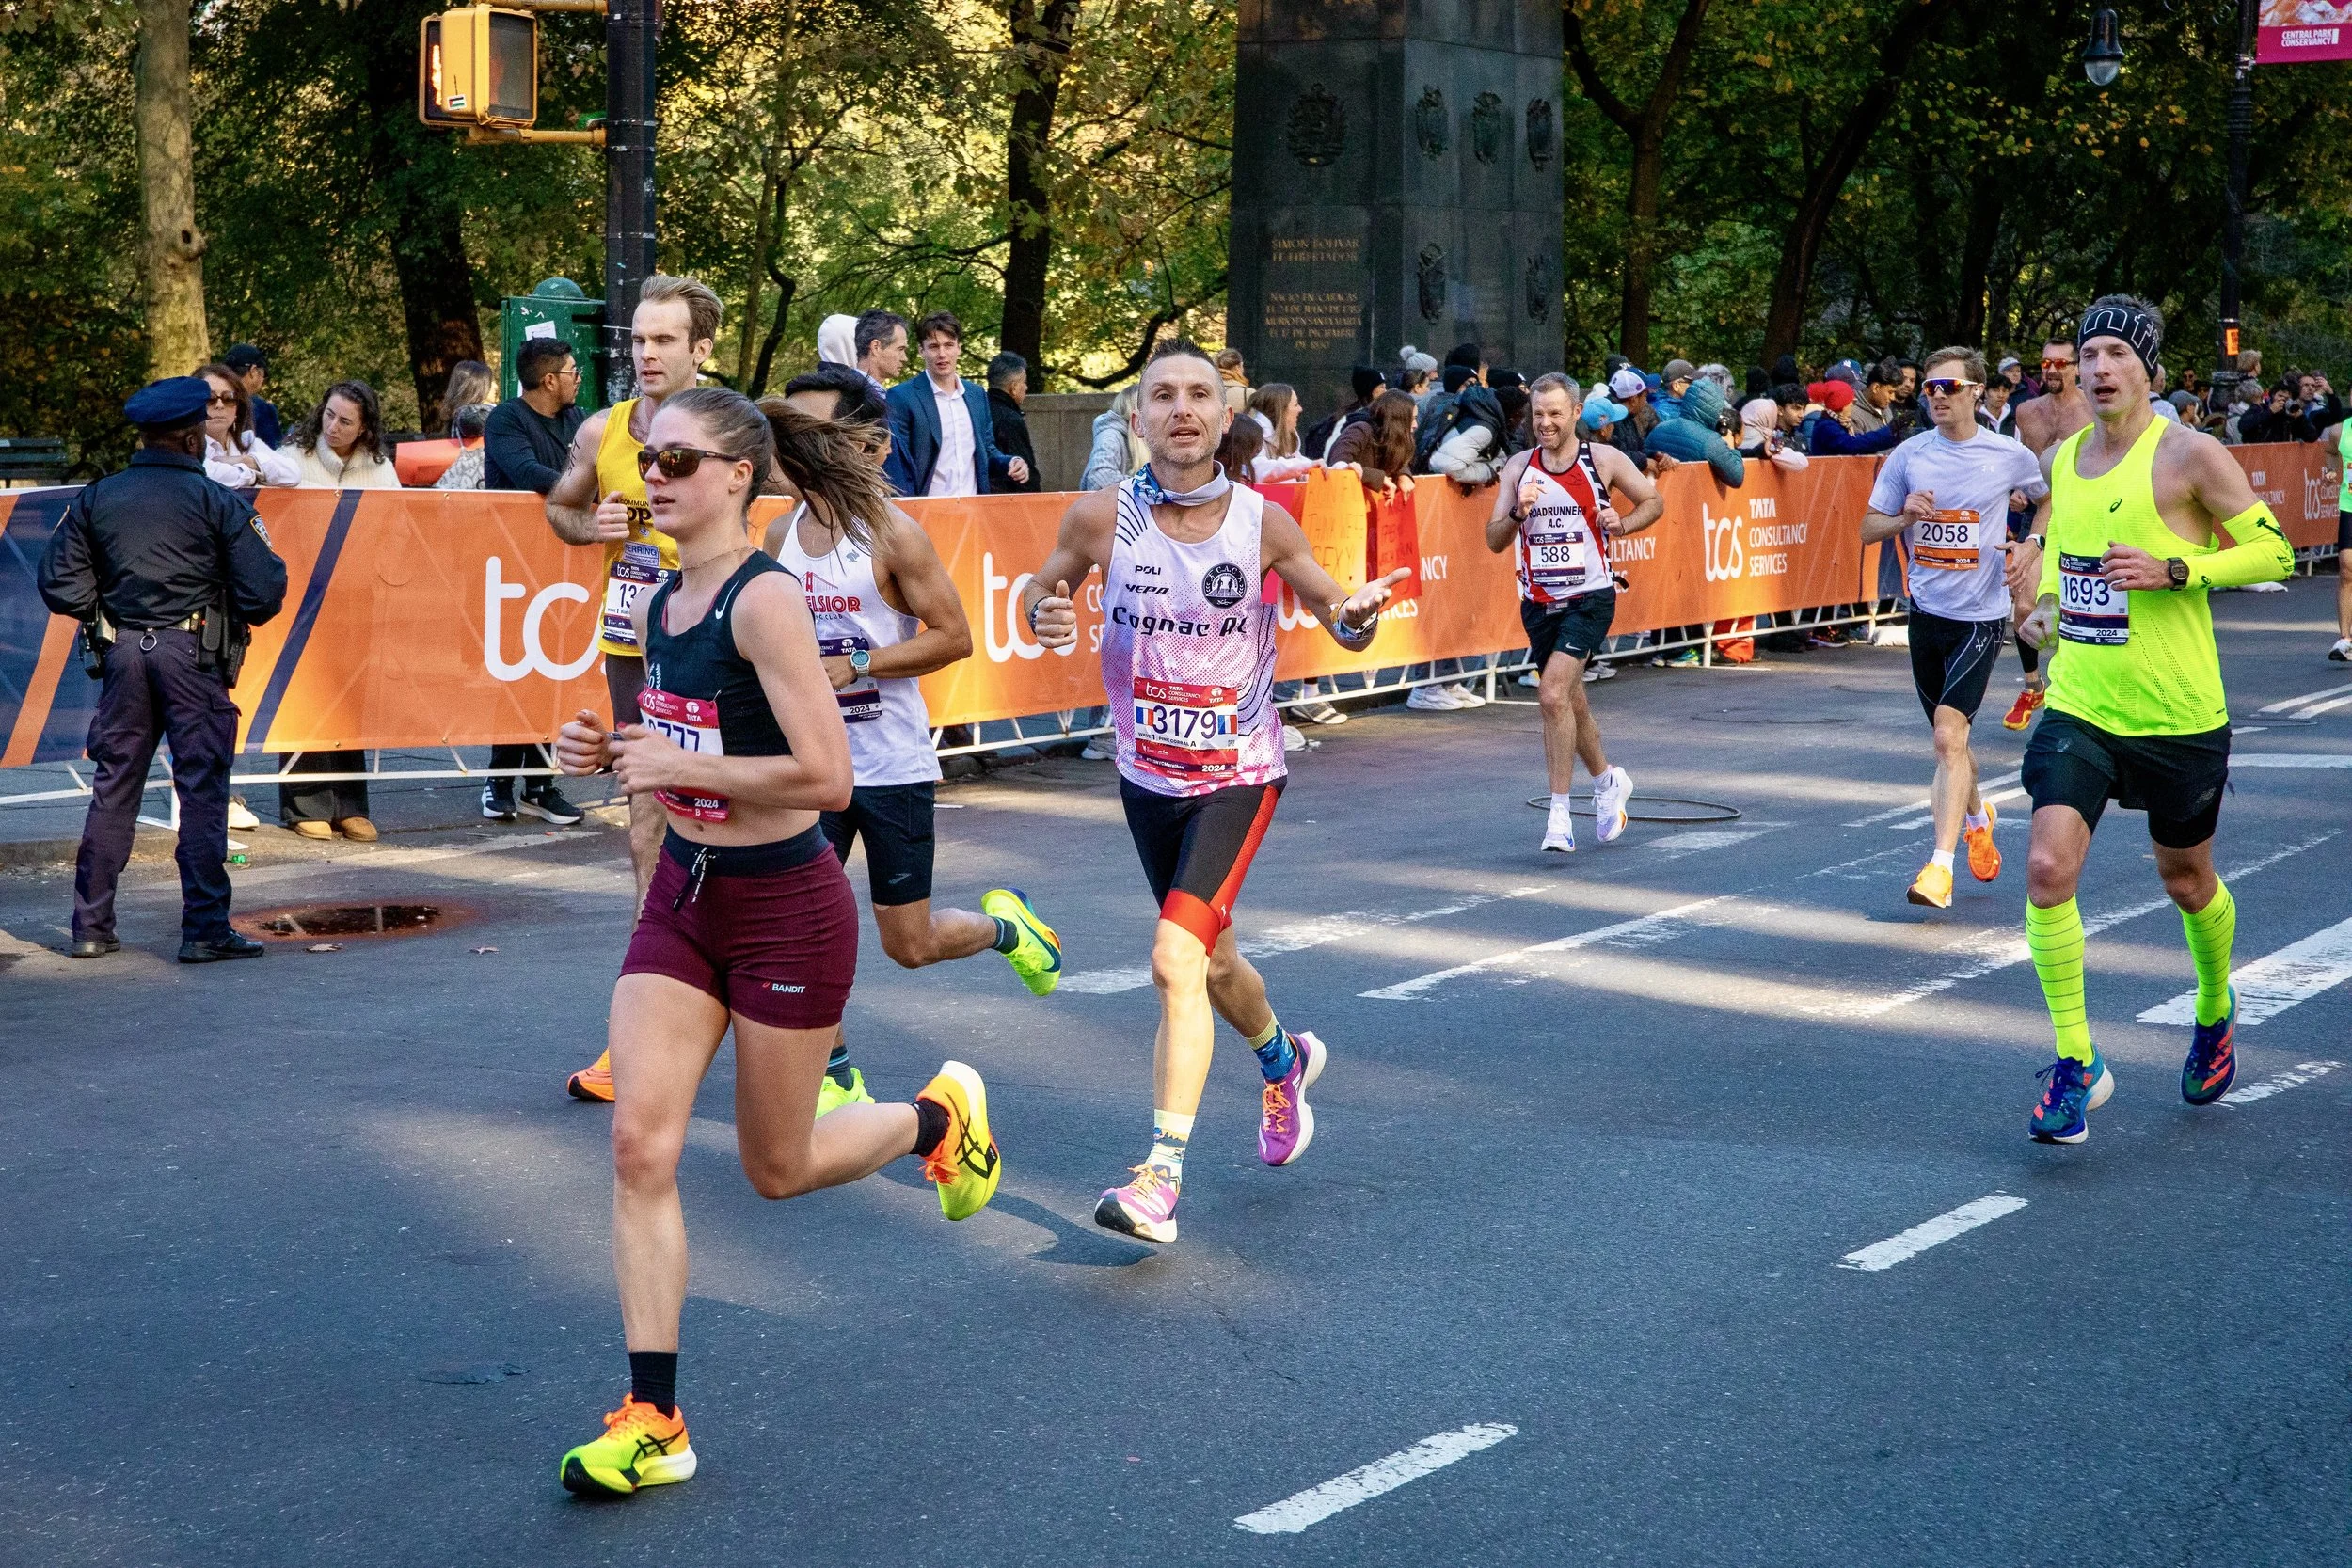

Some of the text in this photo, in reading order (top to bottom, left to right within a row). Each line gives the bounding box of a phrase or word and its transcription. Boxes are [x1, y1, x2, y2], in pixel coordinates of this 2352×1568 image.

[2281, 28, 2333, 40] CENTRAL PARK
[2281, 38, 2331, 47] CONSERVANCY
[2304, 468, 2321, 520] tcs
[1749, 497, 1776, 519] TATA
[1548, 518, 1565, 529] A.C.
[1533, 535, 1545, 544] tcs
[1749, 522, 1807, 548] CONSULTANCY
[1921, 523, 1968, 543] 2058
[625, 543, 657, 556] FERRING
[1702, 502, 1743, 582] tcs
[1541, 546, 1570, 563] 588
[617, 564, 630, 578] tcs
[1135, 565, 1161, 575] POLI
[1749, 553, 1788, 578] SERVICES
[619, 583, 646, 609] 13
[1125, 583, 1169, 595] YEPA
[2063, 575, 2110, 606] 1693
[1112, 607, 1210, 637] Cognac
[1146, 682, 1167, 699] tcs
[850, 705, 871, 714] 2024
[686, 714, 703, 722] TATA
[1152, 705, 1216, 739] 3179
[648, 719, 700, 752] 777
[1201, 764, 1226, 772] 2024
[694, 798, 719, 809] 2024
[772, 983, 805, 993] BANDIT
